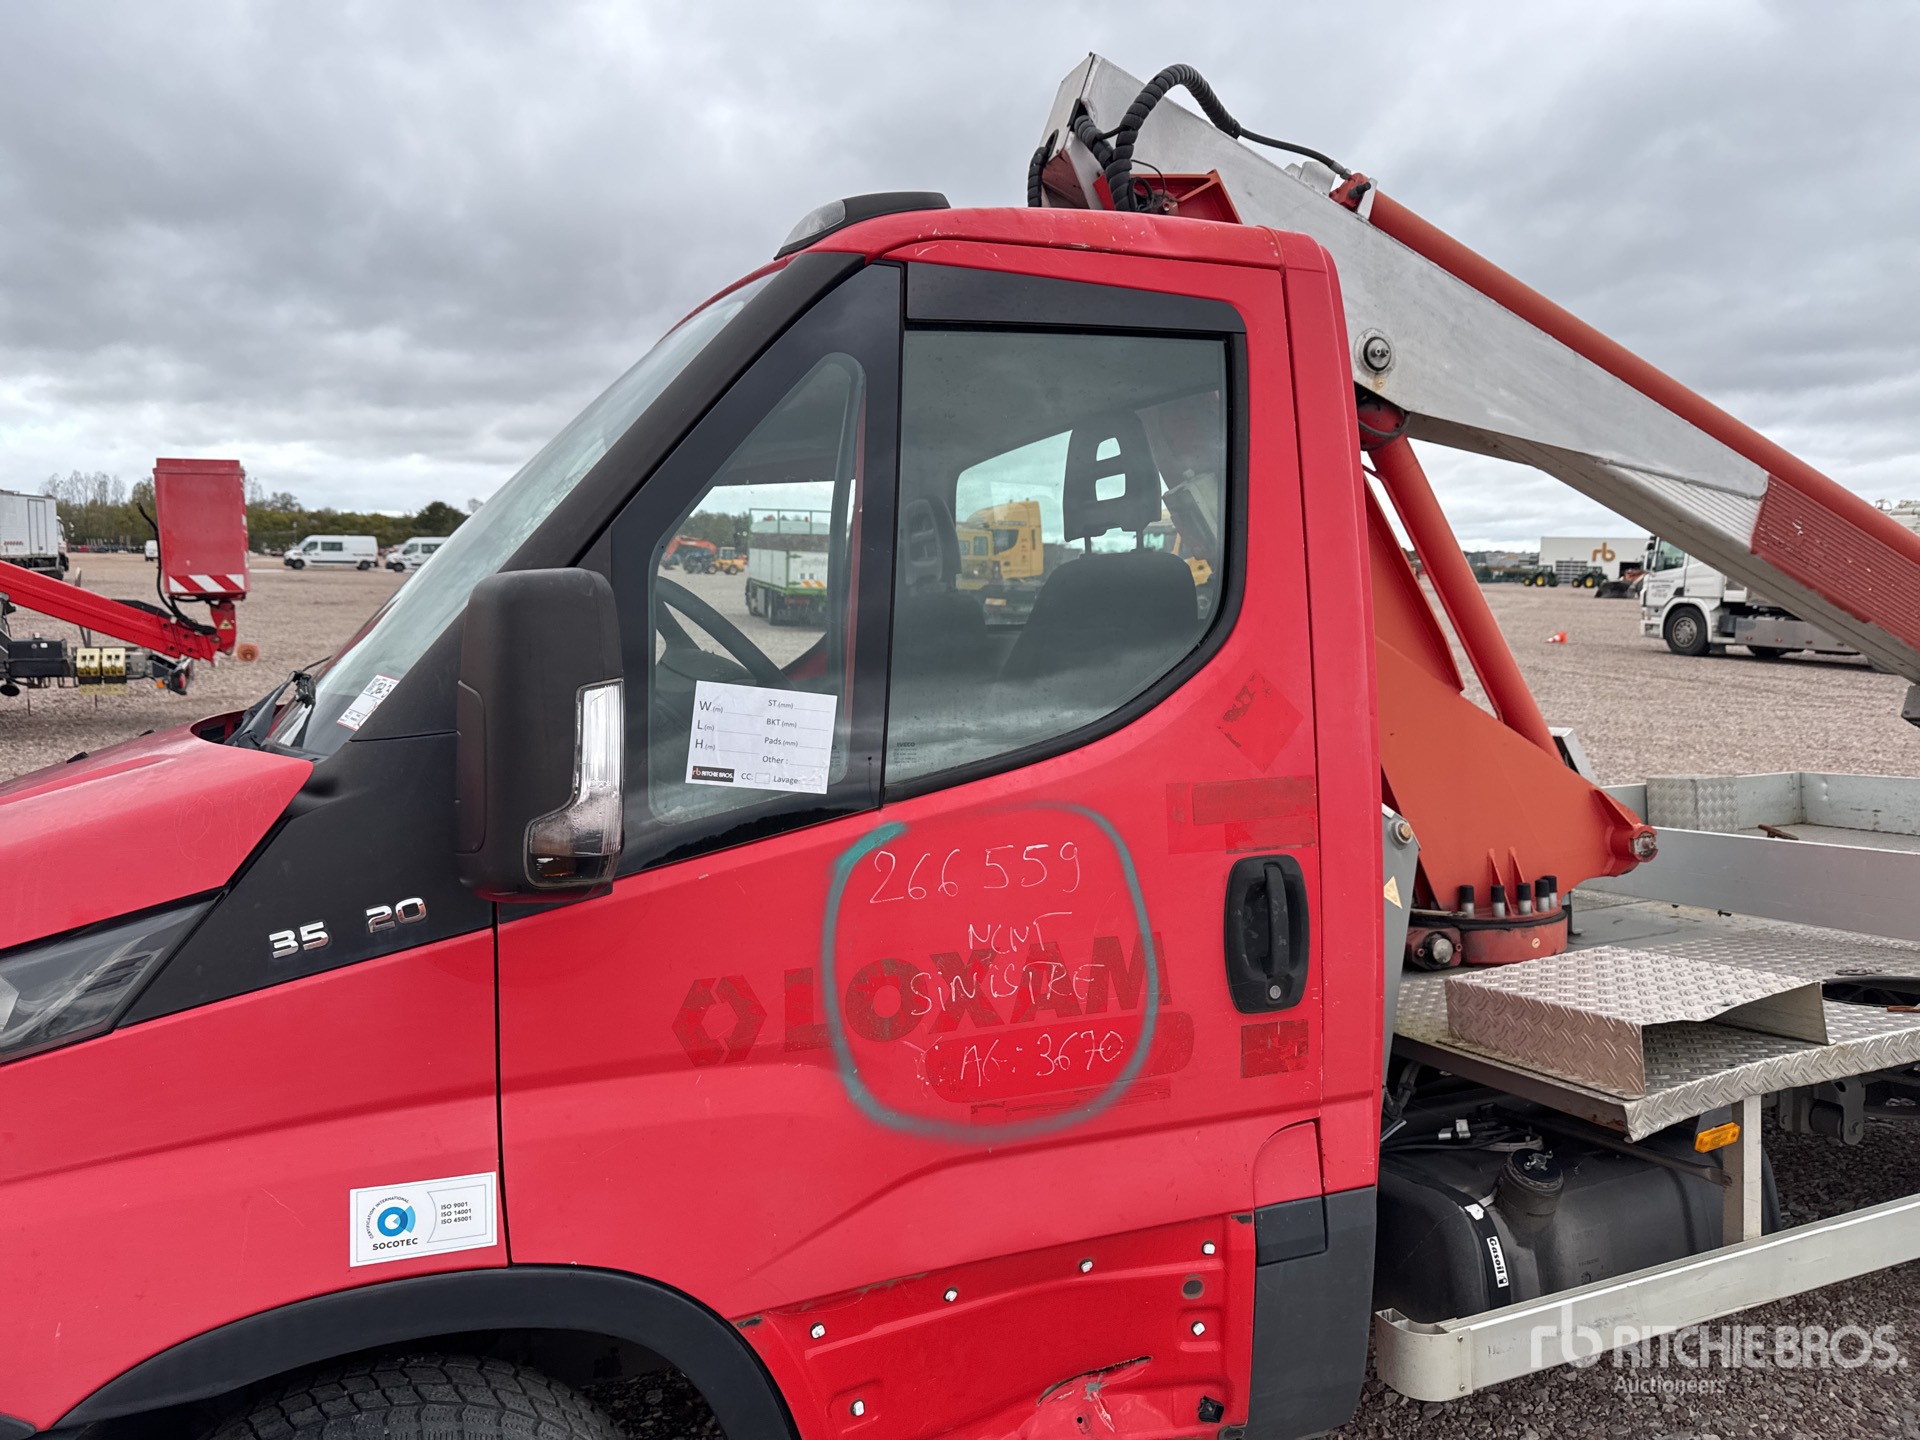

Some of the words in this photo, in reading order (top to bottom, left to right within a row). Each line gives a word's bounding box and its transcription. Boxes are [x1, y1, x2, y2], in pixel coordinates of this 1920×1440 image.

[1591, 542, 1616, 562] rb
[699, 701, 712, 711] W
[768, 699, 777, 707] ST
[766, 718, 780, 726] BKT
[695, 738, 704, 749] H
[764, 736, 782, 745] Pads
[268, 921, 329, 959] 35
[365, 897, 427, 934] 20
[784, 932, 1173, 1053] LOXAM
[1035, 1030, 1124, 1077] 3670
[453, 1201, 468, 1209] 9001
[453, 1208, 472, 1216] 14001
[441, 1217, 452, 1225] ISO
[453, 1215, 472, 1223] 45001
[372, 1237, 418, 1251] SOCOTEC
[1489, 1237, 1505, 1275] Gasoil
